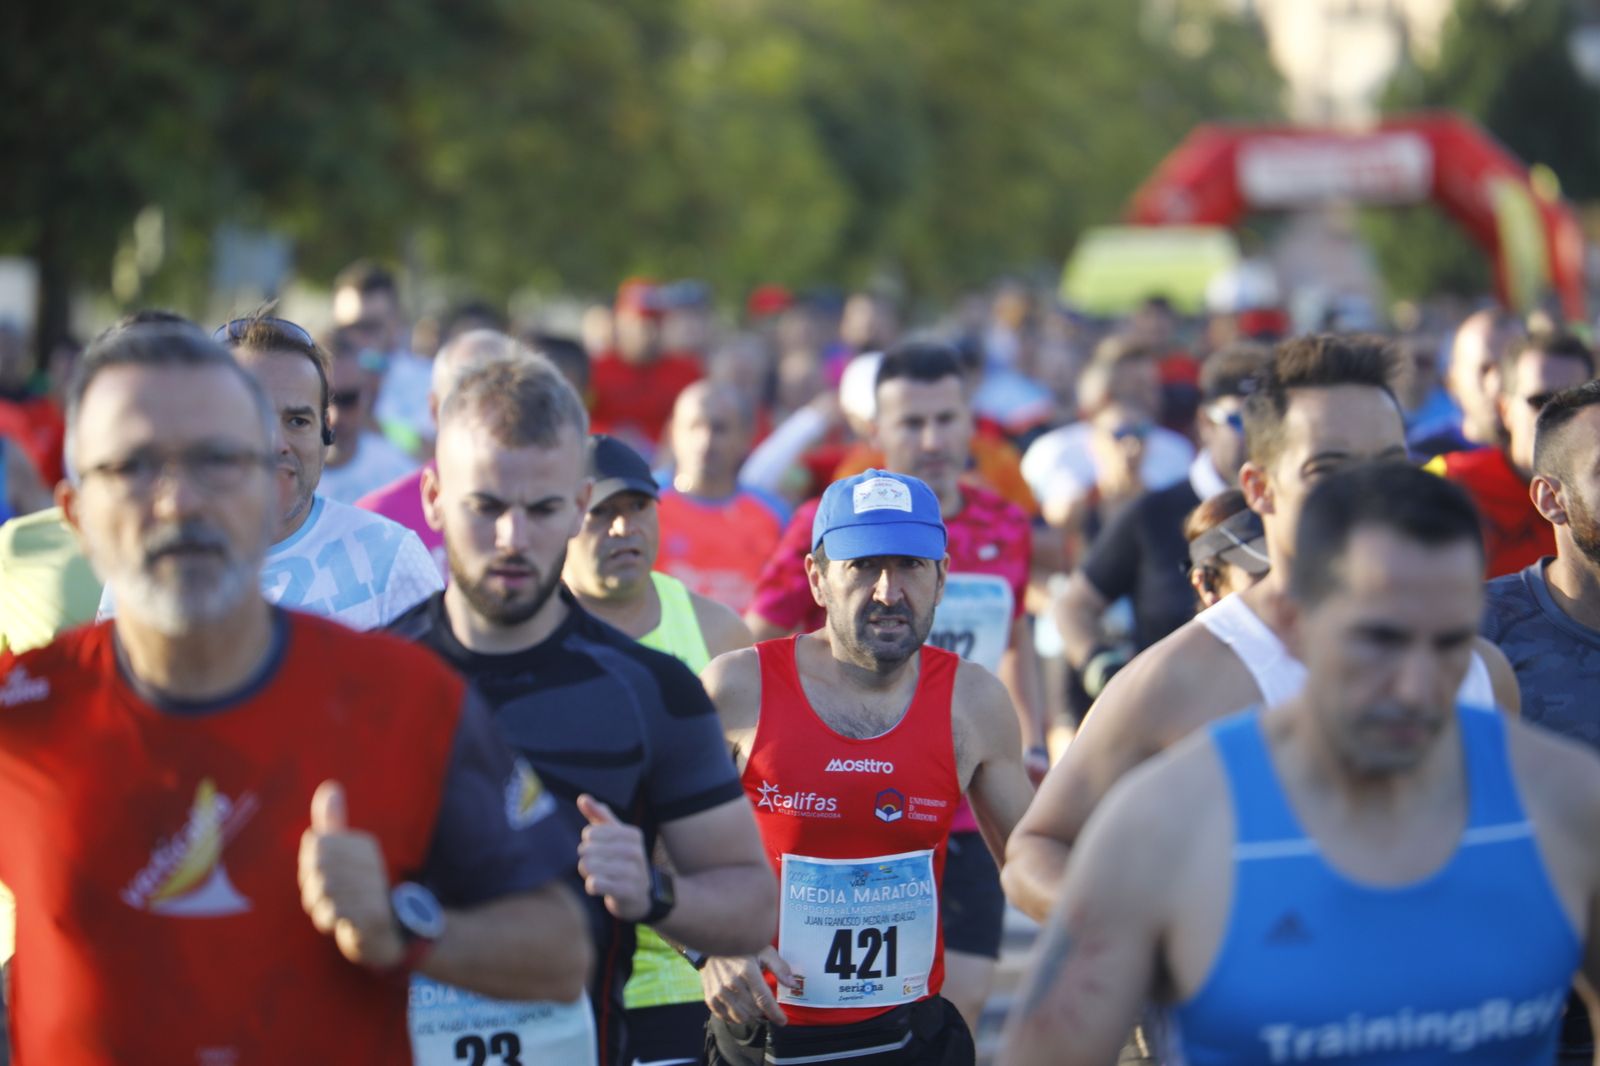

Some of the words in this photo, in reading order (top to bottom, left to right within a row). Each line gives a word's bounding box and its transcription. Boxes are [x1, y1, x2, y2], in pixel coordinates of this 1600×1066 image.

[824, 758, 894, 774] Mosttro
[773, 791, 838, 812] califas
[789, 885, 847, 904] MEDIA
[854, 878, 931, 904] MARATÓN
[804, 916, 823, 926] JUAN
[824, 916, 860, 927] FRANCISCO
[824, 925, 897, 980] 421
[408, 983, 459, 1006] EDIA
[455, 1031, 523, 1066] 23
